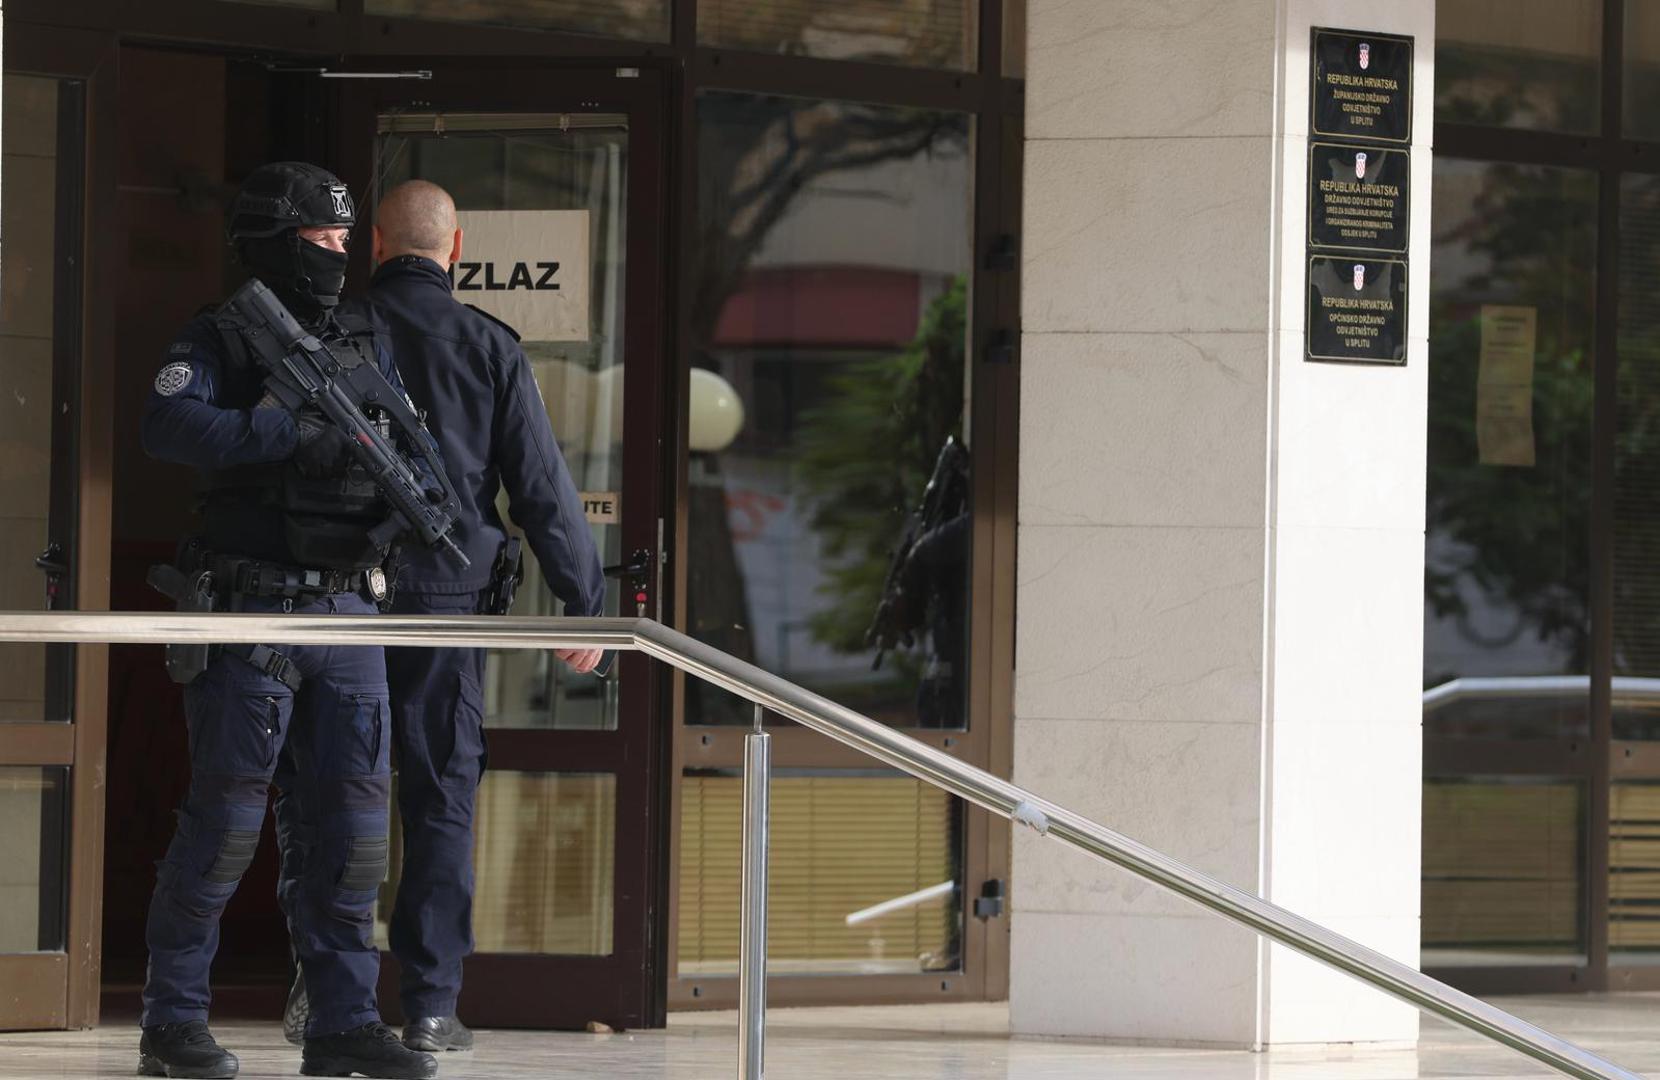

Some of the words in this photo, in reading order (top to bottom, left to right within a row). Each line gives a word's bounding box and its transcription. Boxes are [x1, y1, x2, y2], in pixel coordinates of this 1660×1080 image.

[1327, 73, 1363, 86] REPUBLIKA
[1364, 77, 1398, 90] HRVATSKA
[1320, 180, 1361, 193] REPUBLIKA
[1362, 183, 1399, 197] HRVATSKA
[1324, 193, 1351, 205] DRŽAVNO
[1352, 196, 1394, 207] ODVJETNIŠTVO
[1322, 297, 1359, 309] REPUBLIKA
[1360, 299, 1393, 311] HRVATSKA
[1350, 338, 1370, 348] SPLITU
